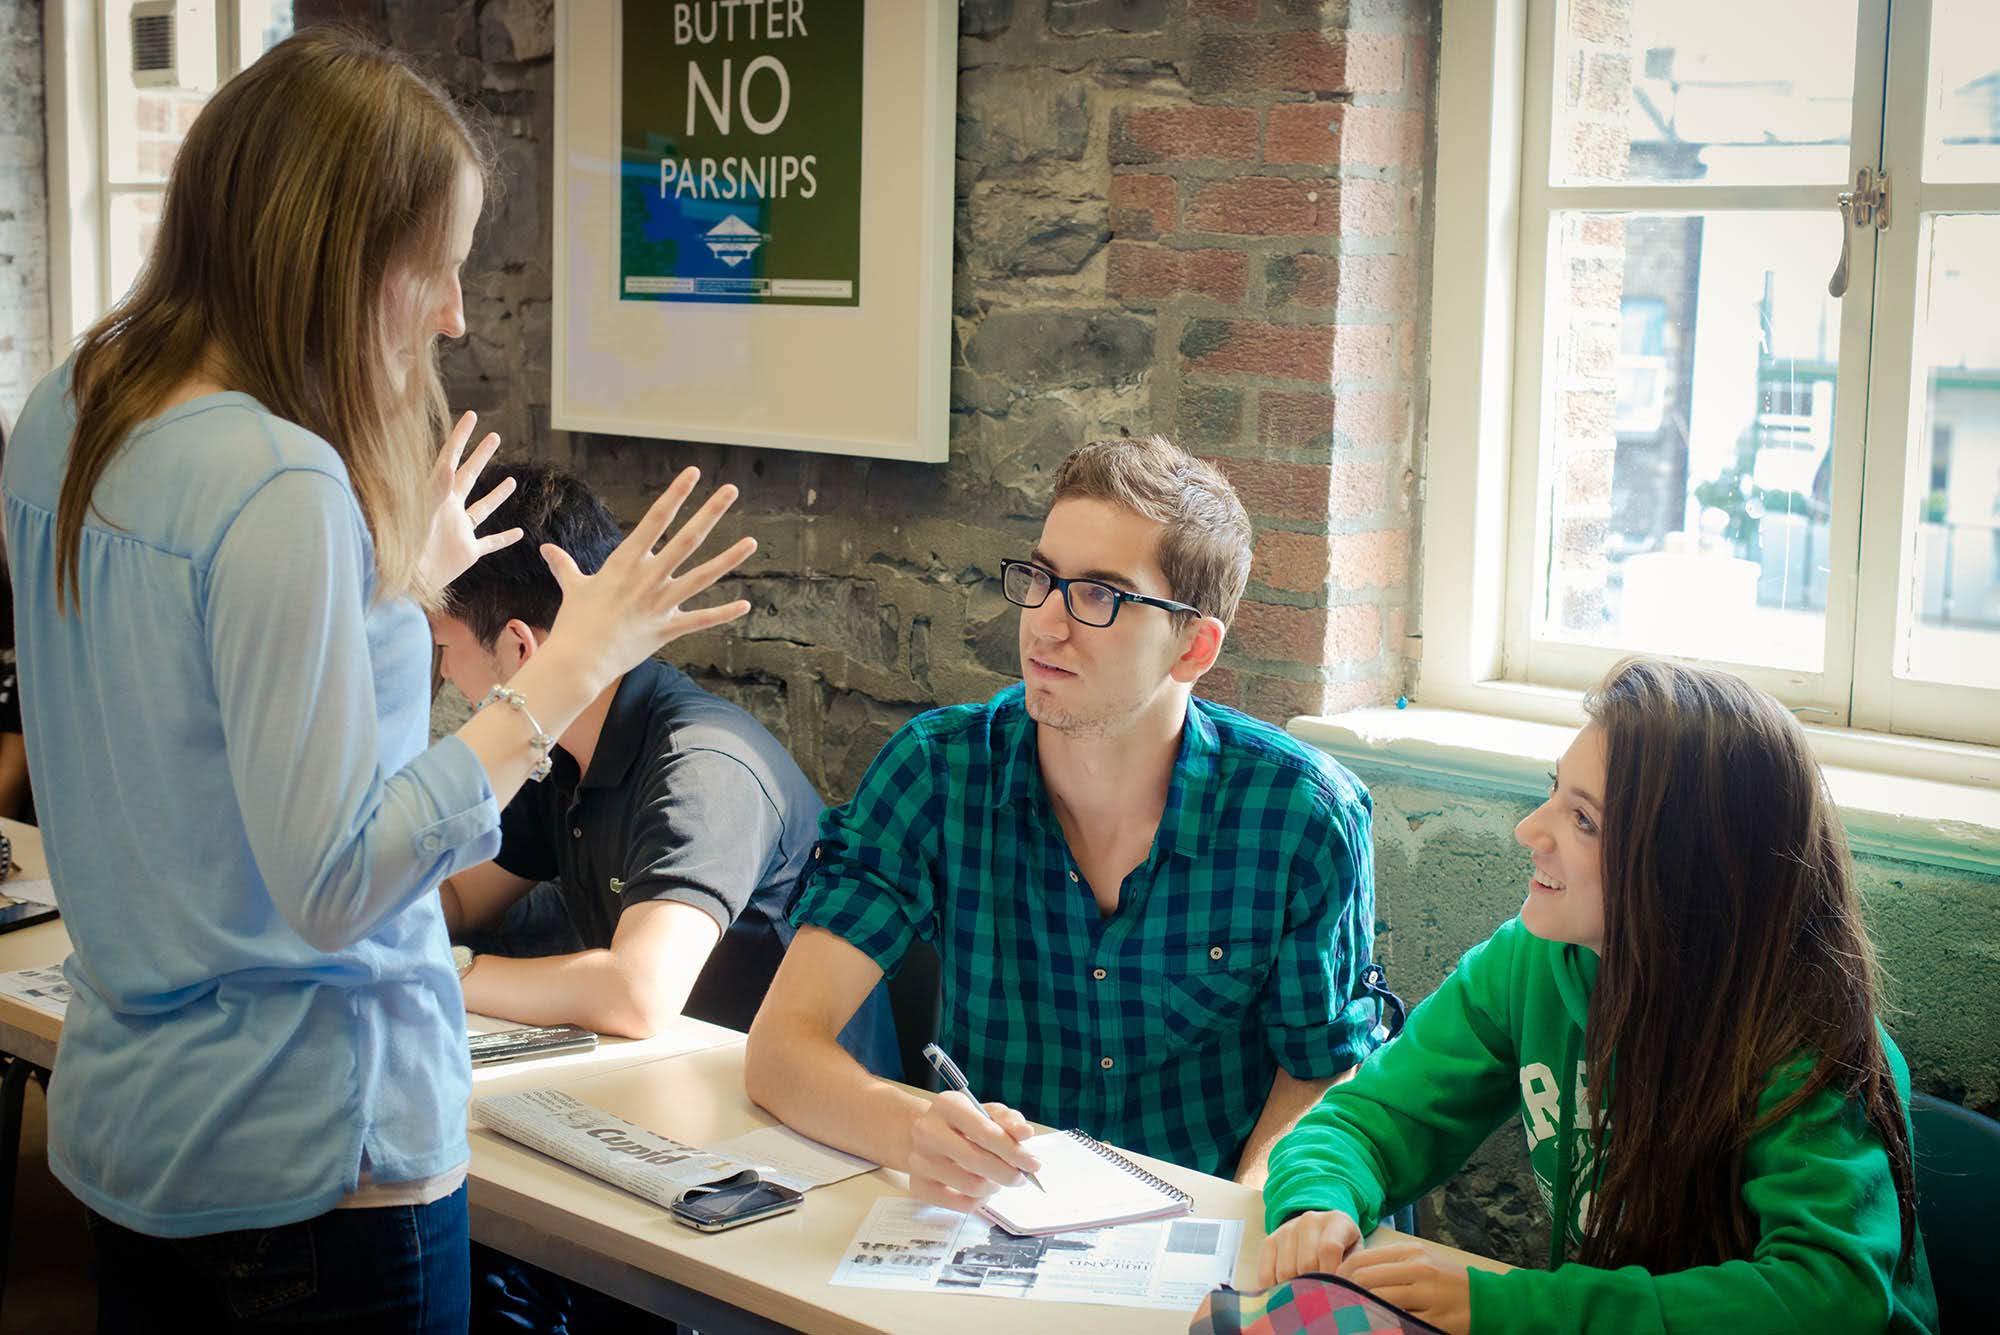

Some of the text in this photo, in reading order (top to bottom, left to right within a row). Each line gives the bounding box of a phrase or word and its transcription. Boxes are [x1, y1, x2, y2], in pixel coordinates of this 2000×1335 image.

[674, 0, 808, 45] BUTTER
[686, 55, 790, 136] NO
[660, 155, 817, 199] PARSNIPS
[585, 1128, 691, 1165] Cupid
